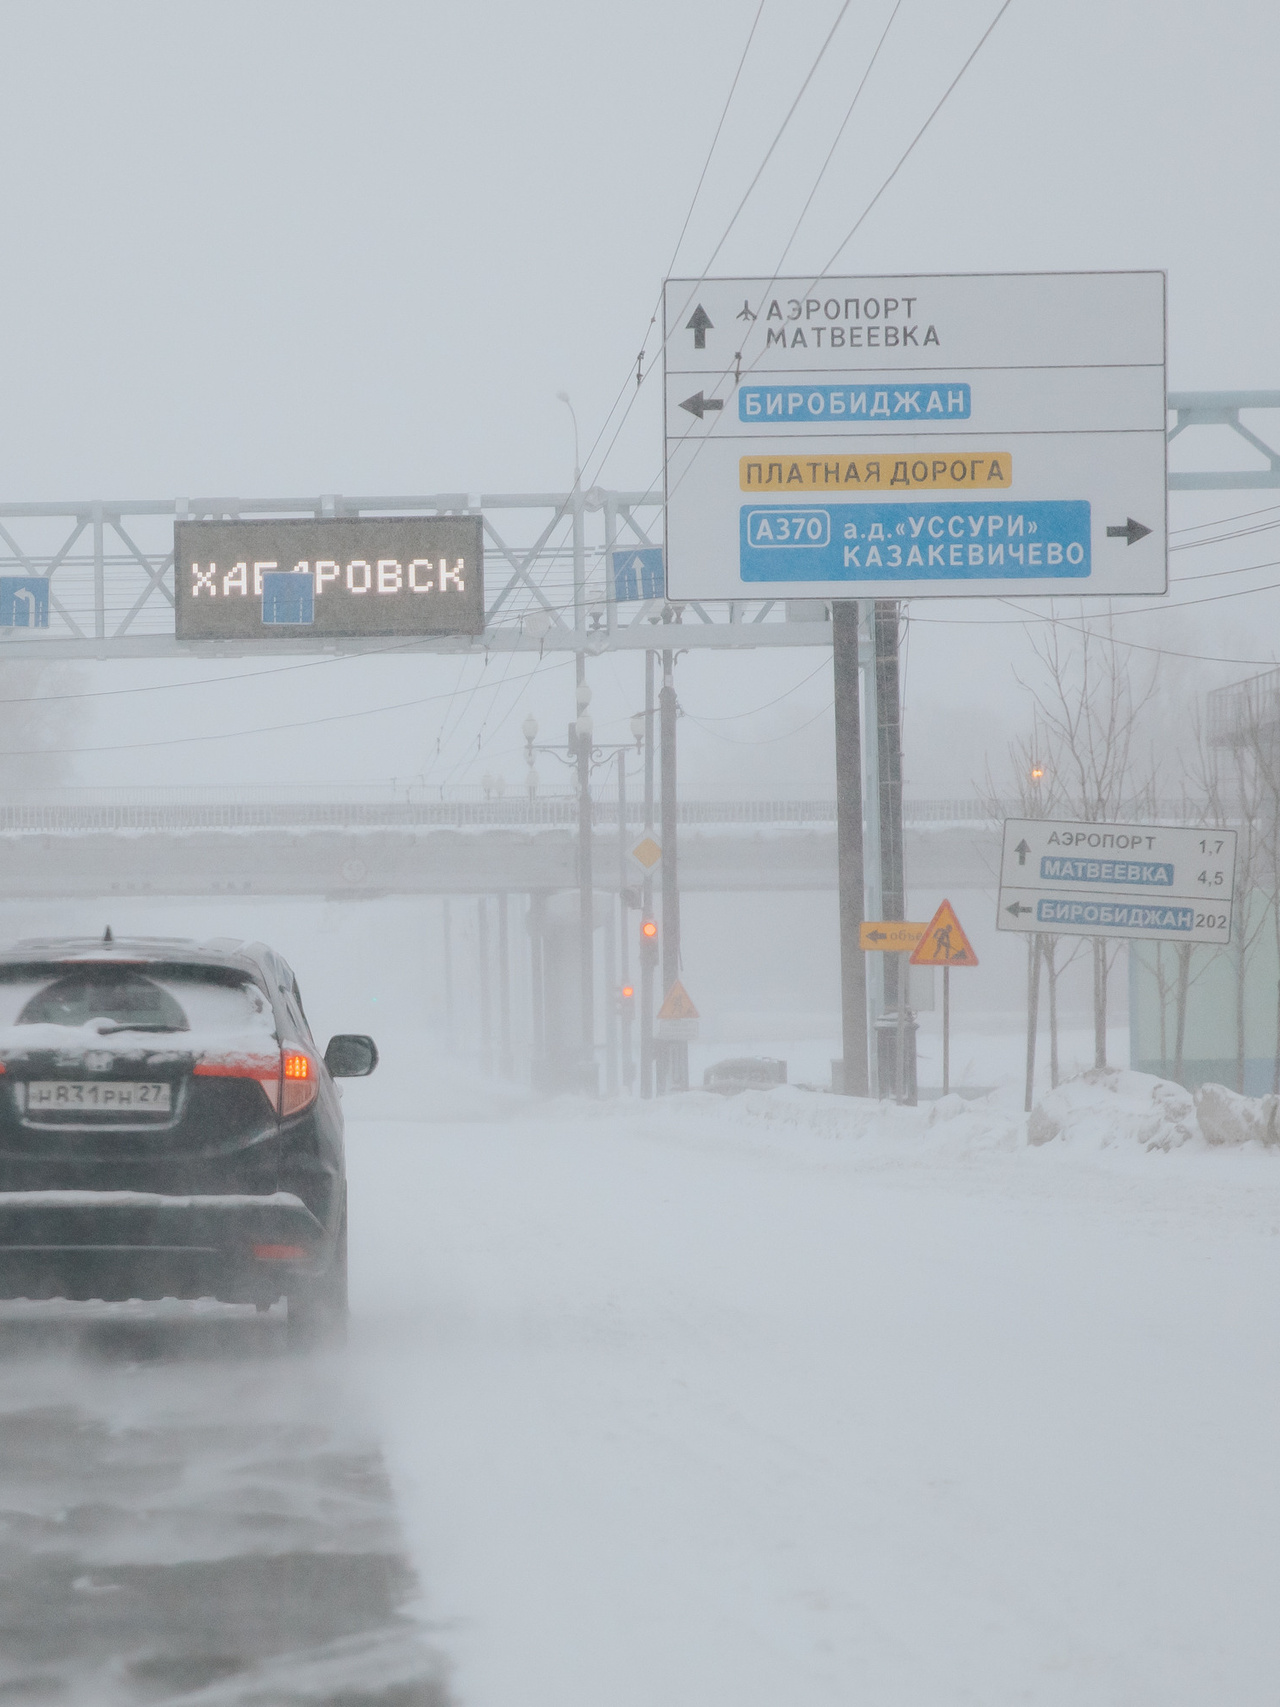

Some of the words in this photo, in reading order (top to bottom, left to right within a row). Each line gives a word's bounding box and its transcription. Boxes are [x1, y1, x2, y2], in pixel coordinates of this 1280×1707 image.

[766, 298, 918, 322] АЭРОПОРТ
[766, 325, 941, 349] МАТВЕЕВКА
[745, 389, 966, 417] БИРОБИДЖАН
[746, 461, 881, 485] ПЛАТНАЯ
[890, 459, 1005, 486] ДОРОГА
[756, 518, 822, 540] А370
[844, 543, 1085, 567] КАЗАКЕВИЧЕВО
[1047, 831, 1157, 850] АЭРОПОРТ
[1199, 839, 1224, 856] 1,7
[1044, 860, 1169, 882] МАТВЕЕВКА
[1197, 870, 1224, 887] 4,5
[1041, 902, 1192, 928] БИРОБИДЖАН
[1195, 914, 1227, 929] 202
[890, 929, 923, 941] объе
[139, 1084, 162, 1102] 27
